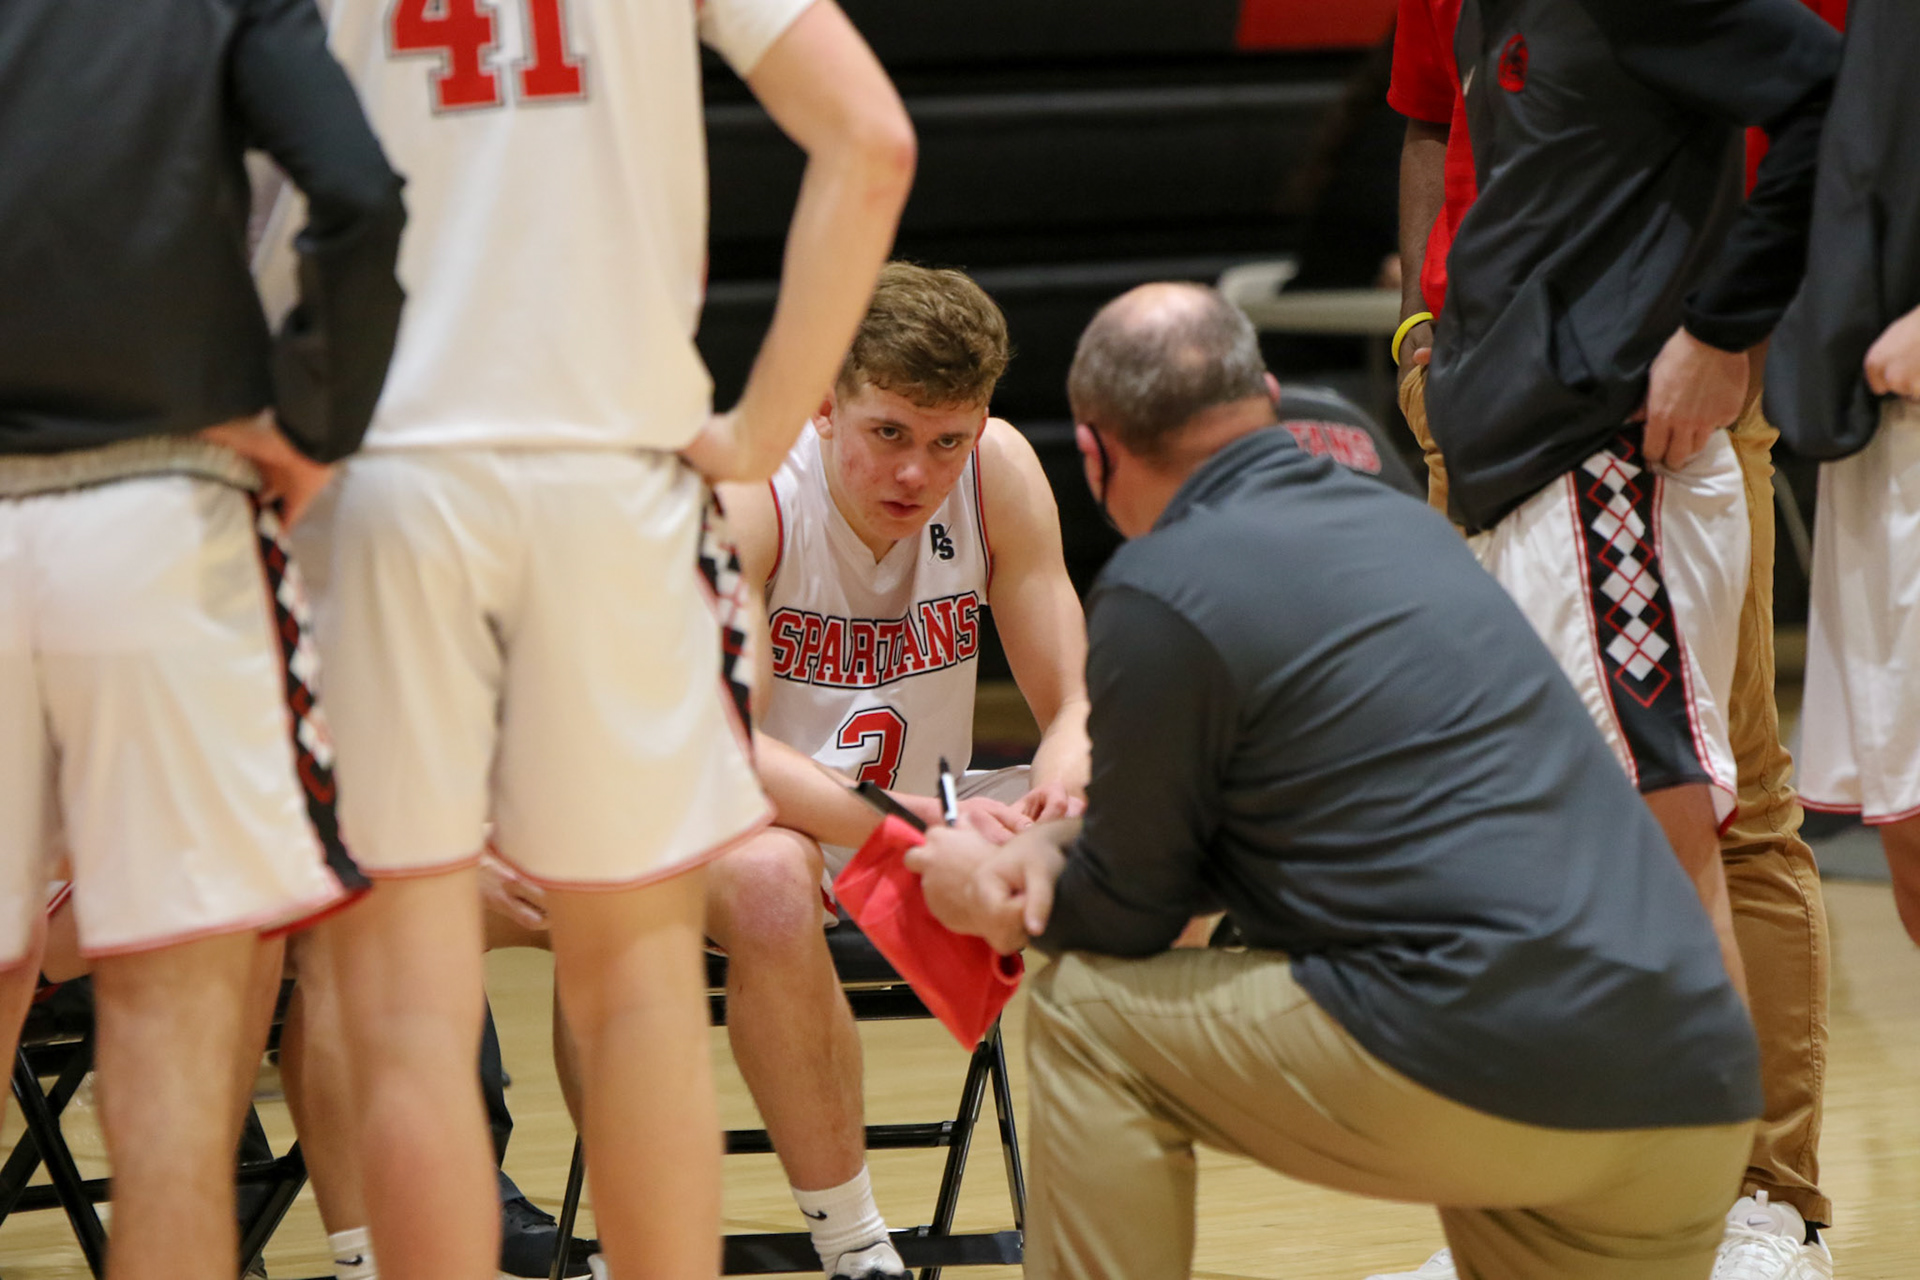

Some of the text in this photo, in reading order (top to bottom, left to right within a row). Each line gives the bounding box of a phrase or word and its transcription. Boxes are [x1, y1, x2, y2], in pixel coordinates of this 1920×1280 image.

[385, 0, 589, 116] 41
[769, 590, 979, 689] SPARTANS
[836, 706, 907, 791] 3
